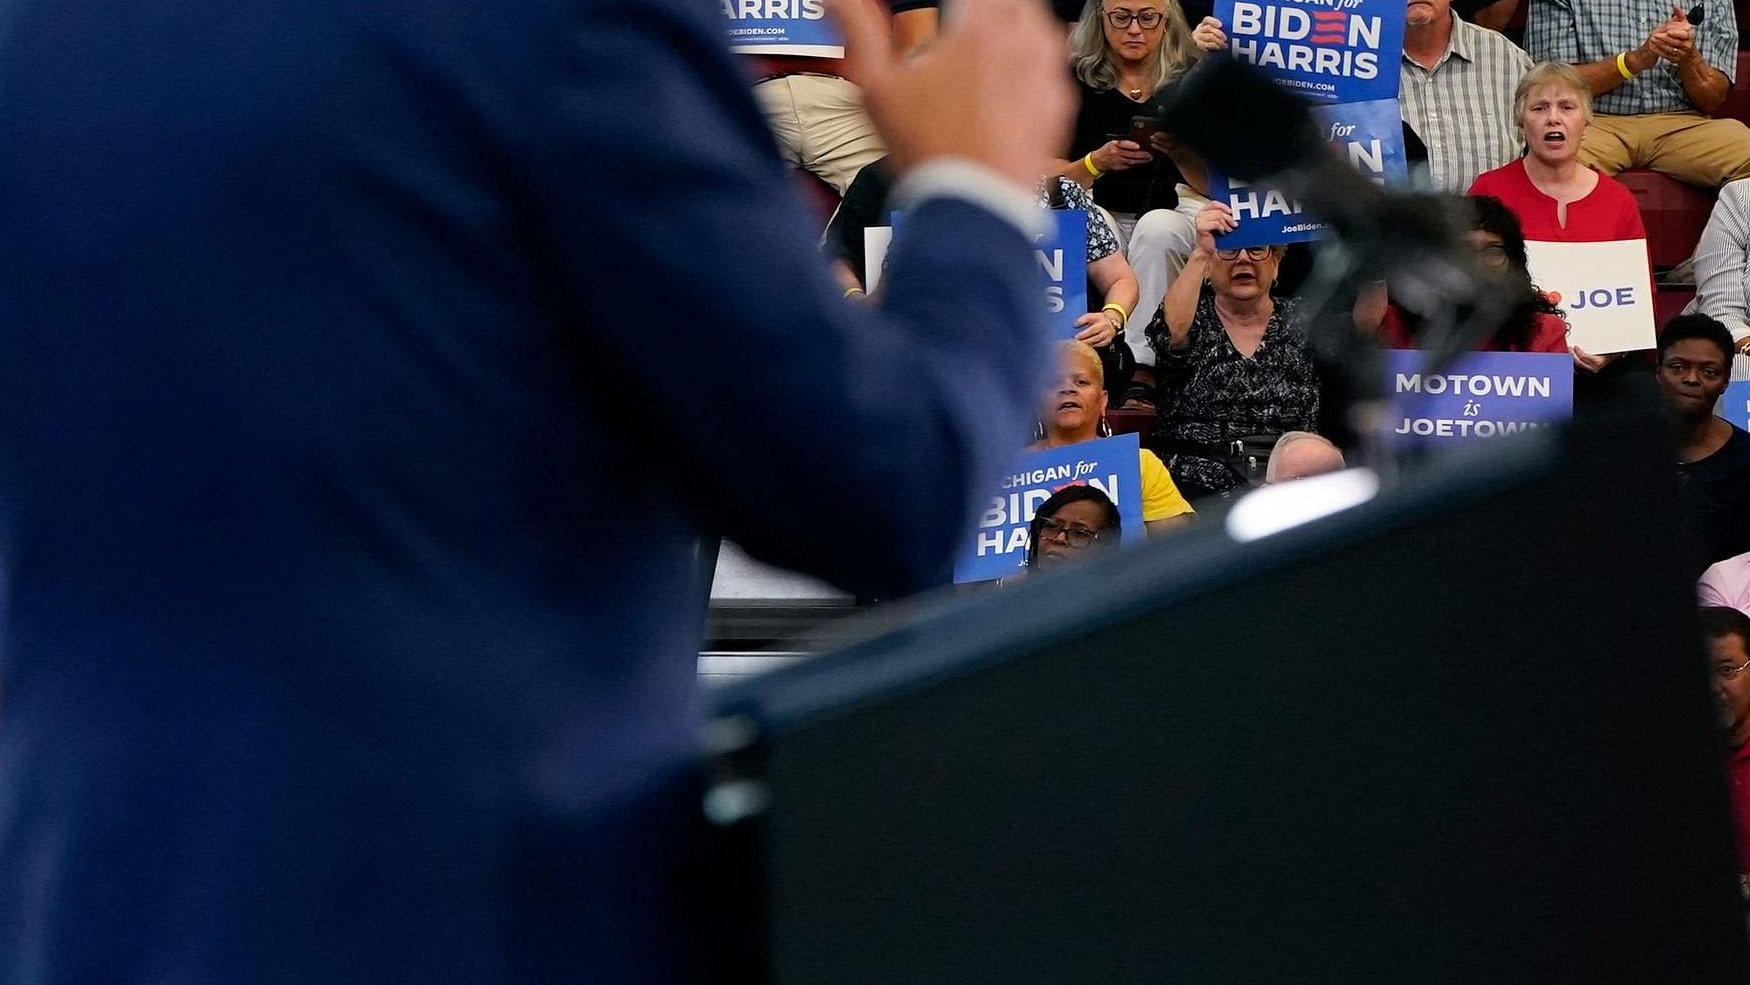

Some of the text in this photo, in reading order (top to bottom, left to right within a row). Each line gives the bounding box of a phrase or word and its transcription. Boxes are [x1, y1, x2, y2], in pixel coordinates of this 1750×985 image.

[1232, 2, 1382, 49] BIDEN
[1231, 38, 1379, 80] HARRIS
[1276, 79, 1335, 92] OEBIDEN.COM
[1329, 122, 1356, 142] for
[1570, 287, 1635, 309] JOE
[1395, 373, 1550, 397] MOTOWN
[1463, 399, 1481, 417] is
[1394, 418, 1549, 438] JOETOW
[1002, 460, 1098, 489] CHIGAN for
